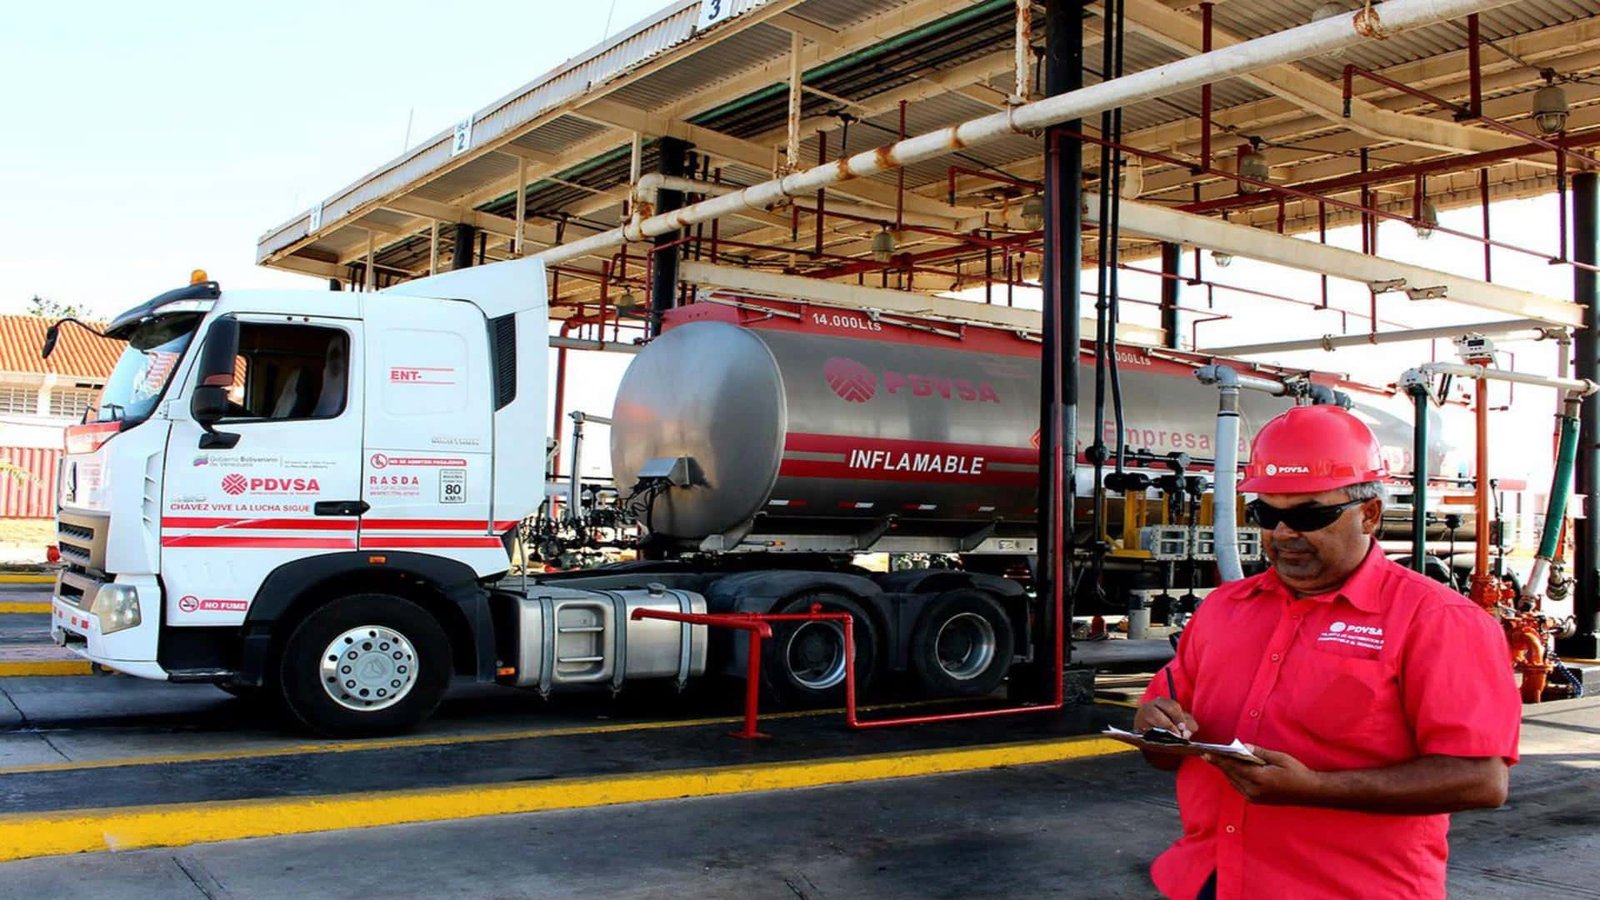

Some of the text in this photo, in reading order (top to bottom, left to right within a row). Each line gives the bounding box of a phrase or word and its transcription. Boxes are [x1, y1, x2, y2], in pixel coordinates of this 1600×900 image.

[708, 0, 721, 20] 3
[457, 132, 465, 151] 2
[812, 313, 882, 332] 14.000Lts
[883, 371, 1001, 403] PDVSA
[849, 449, 985, 475] INFLAMABLE
[250, 478, 320, 491] PDVSA
[370, 475, 419, 484] RASDA
[445, 484, 461, 495] 80
[170, 503, 209, 511] CHAVEZ
[235, 504, 247, 512] LA
[250, 504, 280, 512] LUCHA
[204, 601, 246, 610] NO FUME
[1346, 624, 1383, 636] PDVSA
